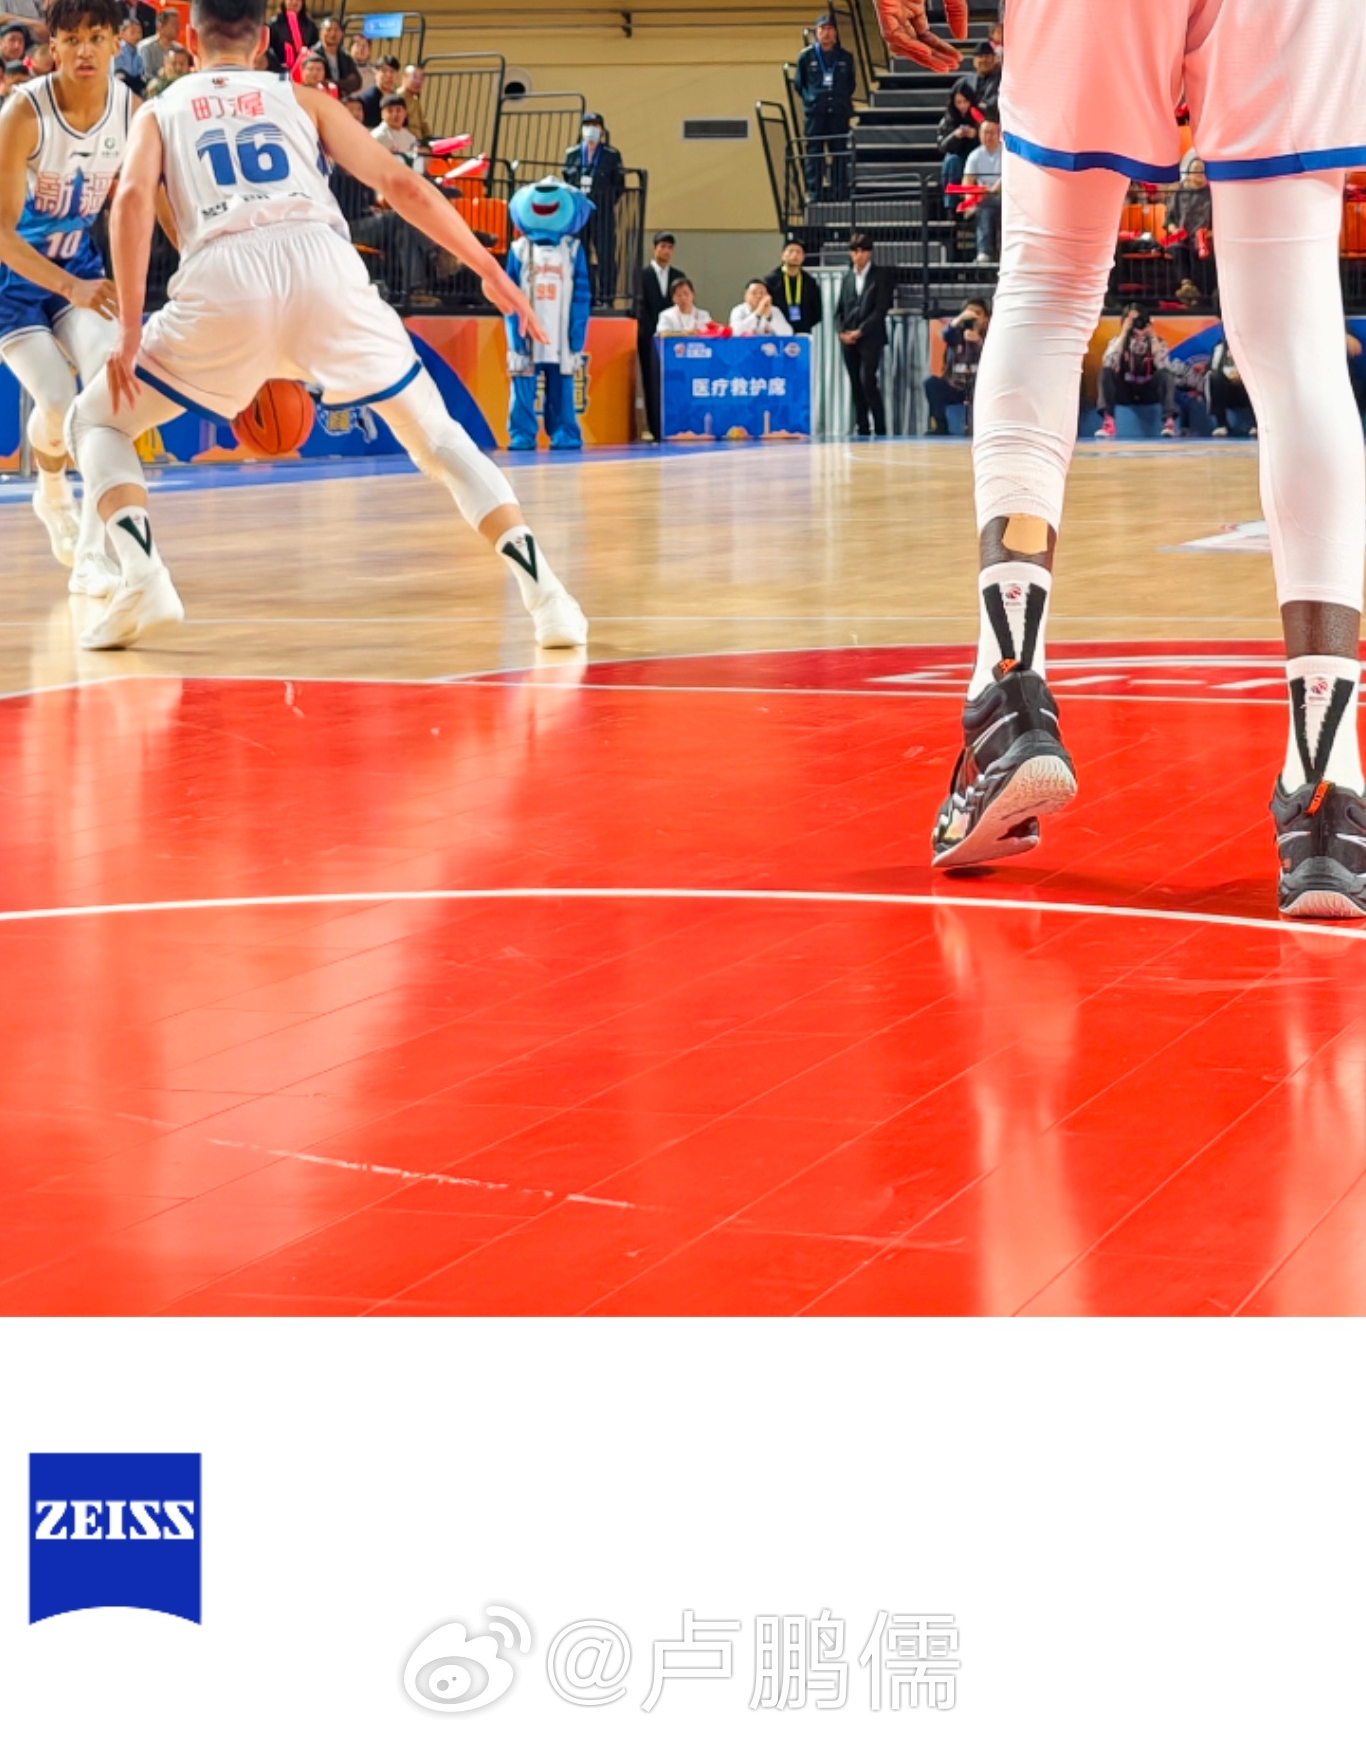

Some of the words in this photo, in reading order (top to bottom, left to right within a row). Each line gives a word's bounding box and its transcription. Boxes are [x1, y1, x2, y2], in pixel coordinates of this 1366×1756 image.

[195, 122, 290, 186] 16
[46, 229, 83, 260] 10
[691, 377, 788, 399] 医疗救护席
